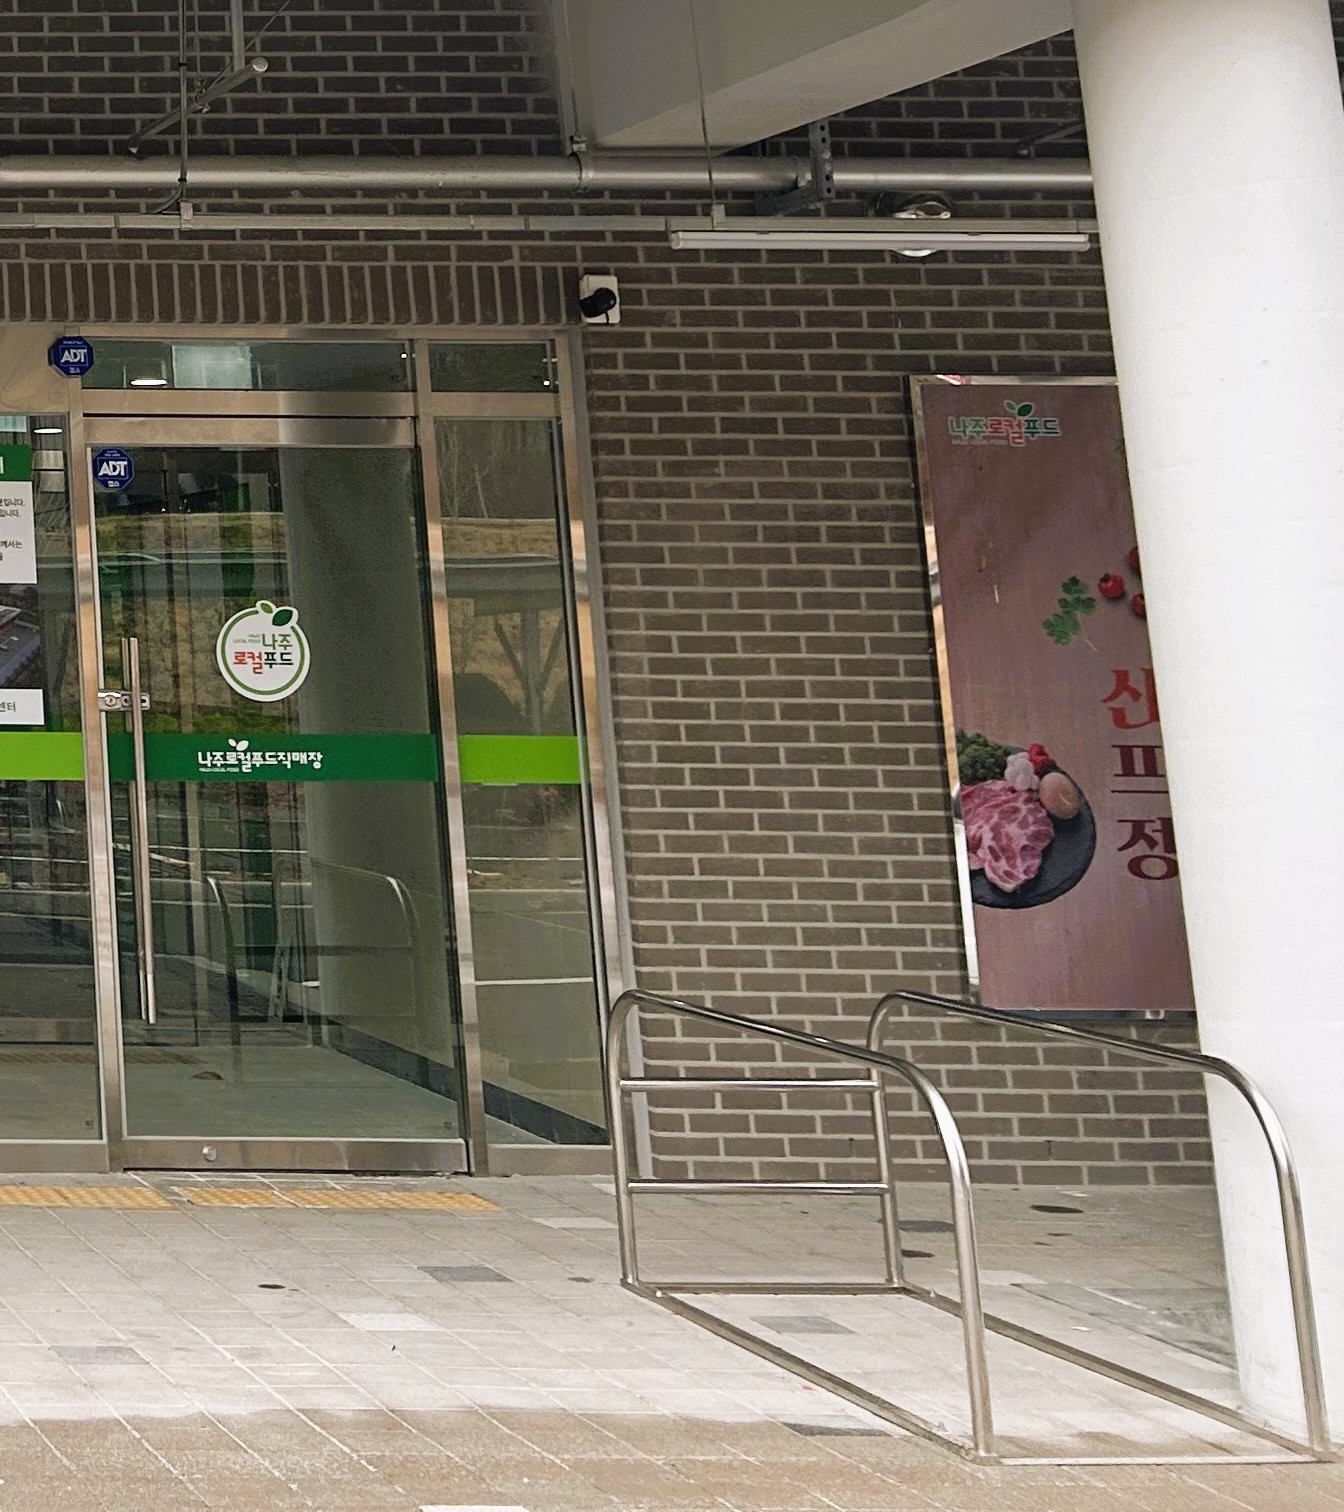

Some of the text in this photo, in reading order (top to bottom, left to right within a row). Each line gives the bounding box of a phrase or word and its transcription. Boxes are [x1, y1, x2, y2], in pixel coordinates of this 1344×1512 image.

[60, 348, 88, 363] ADT
[948, 416, 1062, 447] 나주로컬푸드
[97, 460, 128, 477] ADT
[261, 633, 293, 651] 나주
[232, 651, 294, 675] 로컬푸드
[197, 750, 324, 773] 나주로컬푸드직매장
